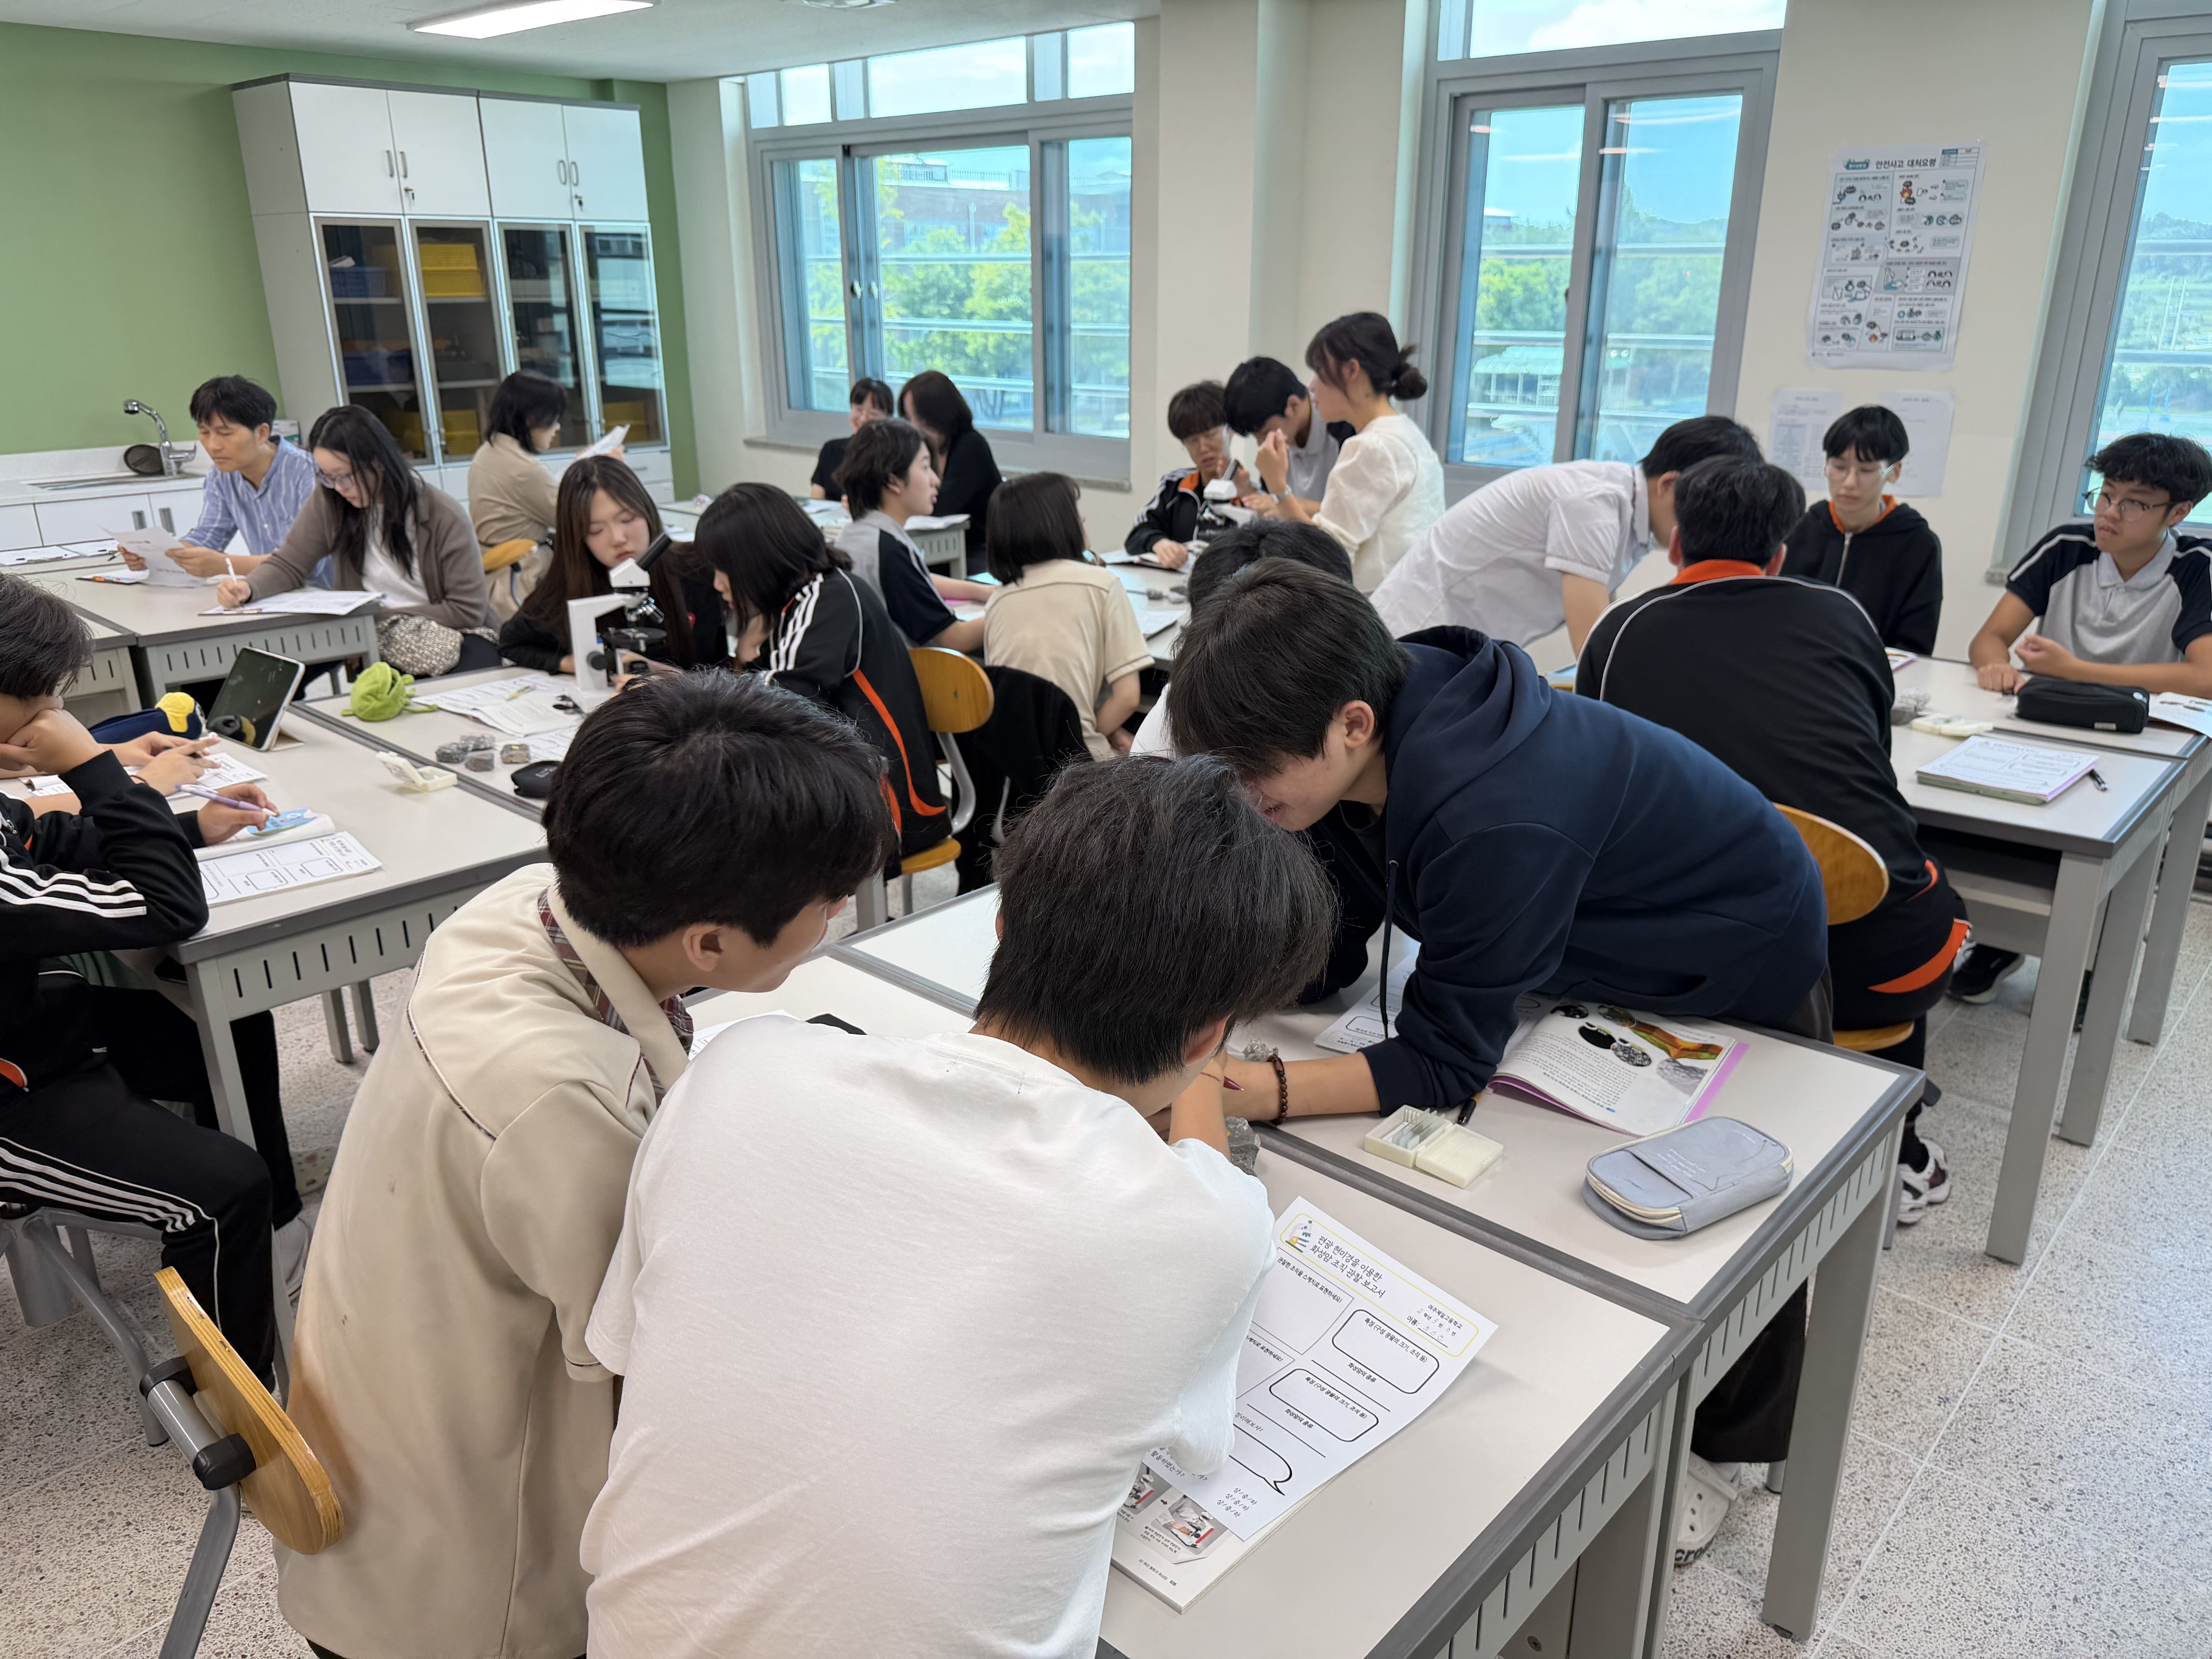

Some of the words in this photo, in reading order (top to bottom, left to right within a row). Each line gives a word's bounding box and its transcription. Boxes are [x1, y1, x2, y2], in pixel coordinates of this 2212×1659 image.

[1278, 1257, 1291, 1269] 관찰한
[1290, 1265, 1304, 1277] 조직을
[1302, 1274, 1320, 1288] 스케치로
[1310, 1244, 1333, 1262] 화성암
[1331, 1259, 1348, 1273] 조직
[1346, 1268, 1363, 1283] 관찰
[1361, 1280, 1386, 1298] 보고서
[1318, 1236, 1333, 1249] 편광
[1333, 1245, 1360, 1267] 현미경을
[1360, 1264, 1382, 1282] 이용한
[1365, 1318, 1375, 1327] 특징
[1374, 1324, 1386, 1335] (구성
[1385, 1332, 1400, 1344] 광물의
[1398, 1341, 1410, 1352] 크기,
[1409, 1349, 1421, 1358] 조직
[1407, 1316, 1419, 1326] 이름:
[1314, 1383, 1327, 1391] (구성
